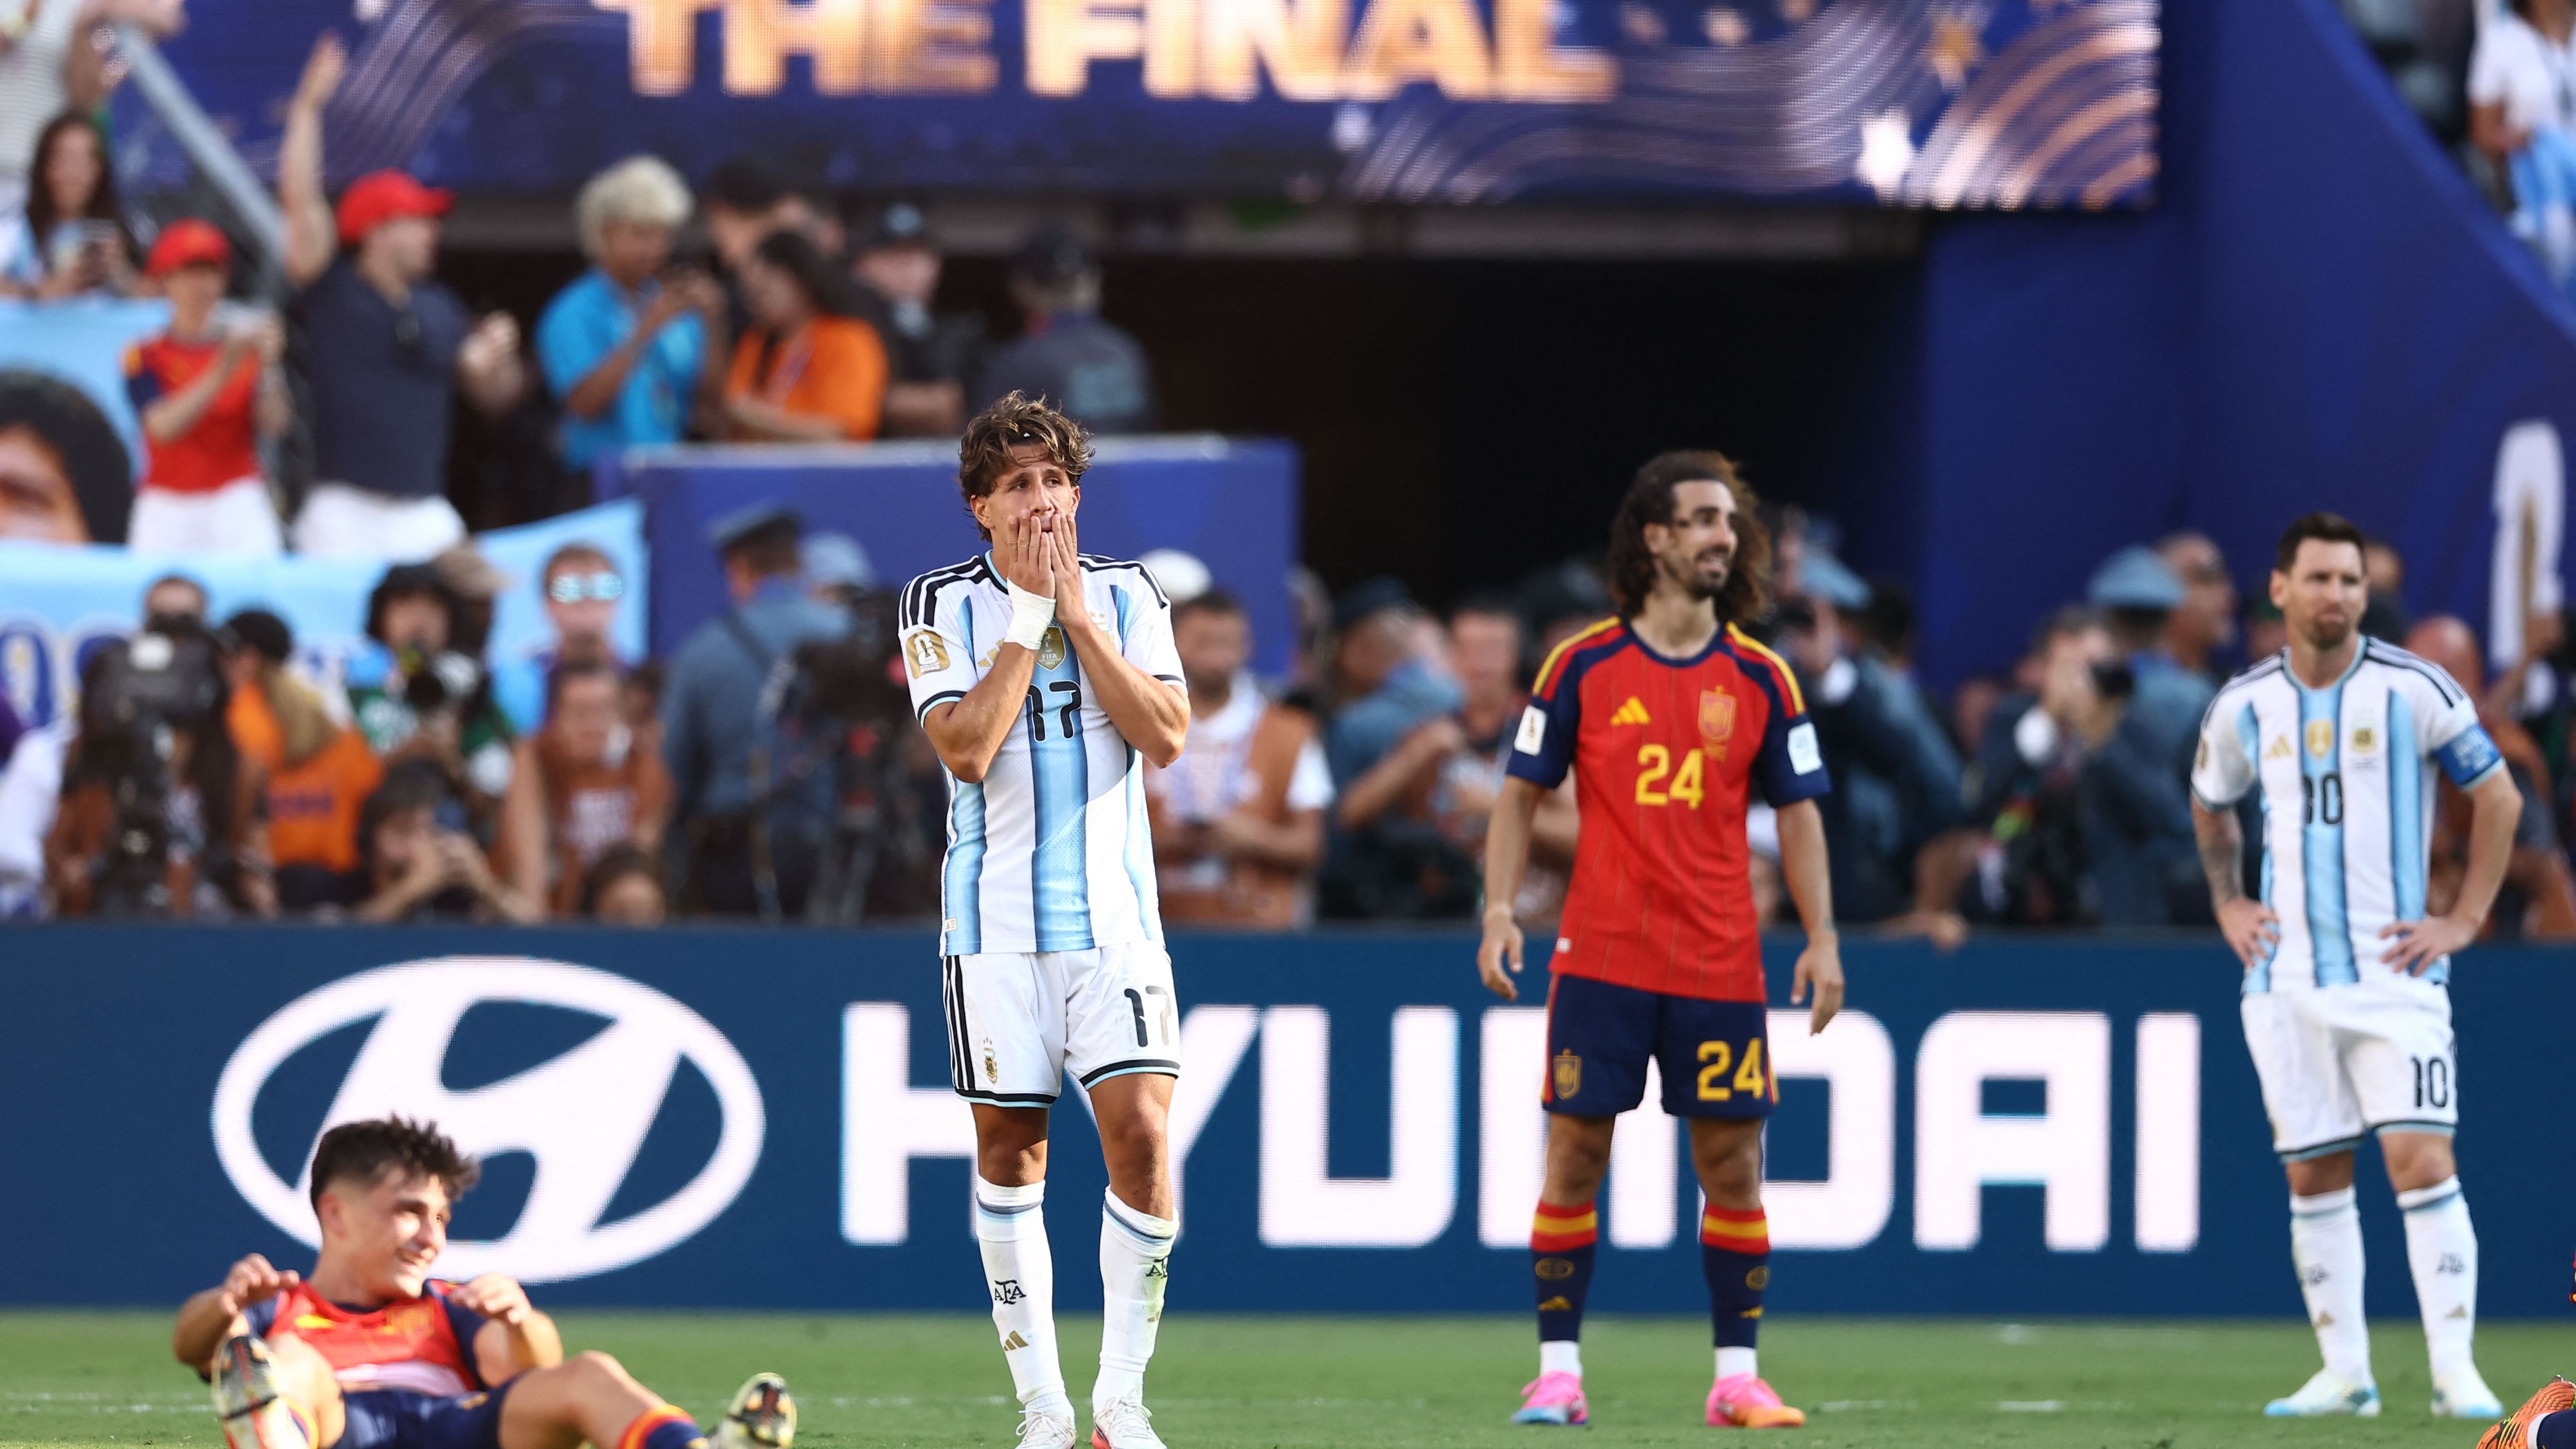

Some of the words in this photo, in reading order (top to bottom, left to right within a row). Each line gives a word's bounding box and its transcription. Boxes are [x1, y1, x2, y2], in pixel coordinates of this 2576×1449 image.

[590, 0, 999, 97] THE
[1024, 0, 1620, 100] FINAL
[1026, 680, 1082, 742] 17
[1635, 743, 1704, 810] 24
[2301, 773, 2343, 824] 10
[1124, 985, 1171, 1048] 17
[1696, 1037, 1765, 1101] 24
[2410, 1056, 2448, 1108] 10
[994, 1279, 1026, 1305] AFA
